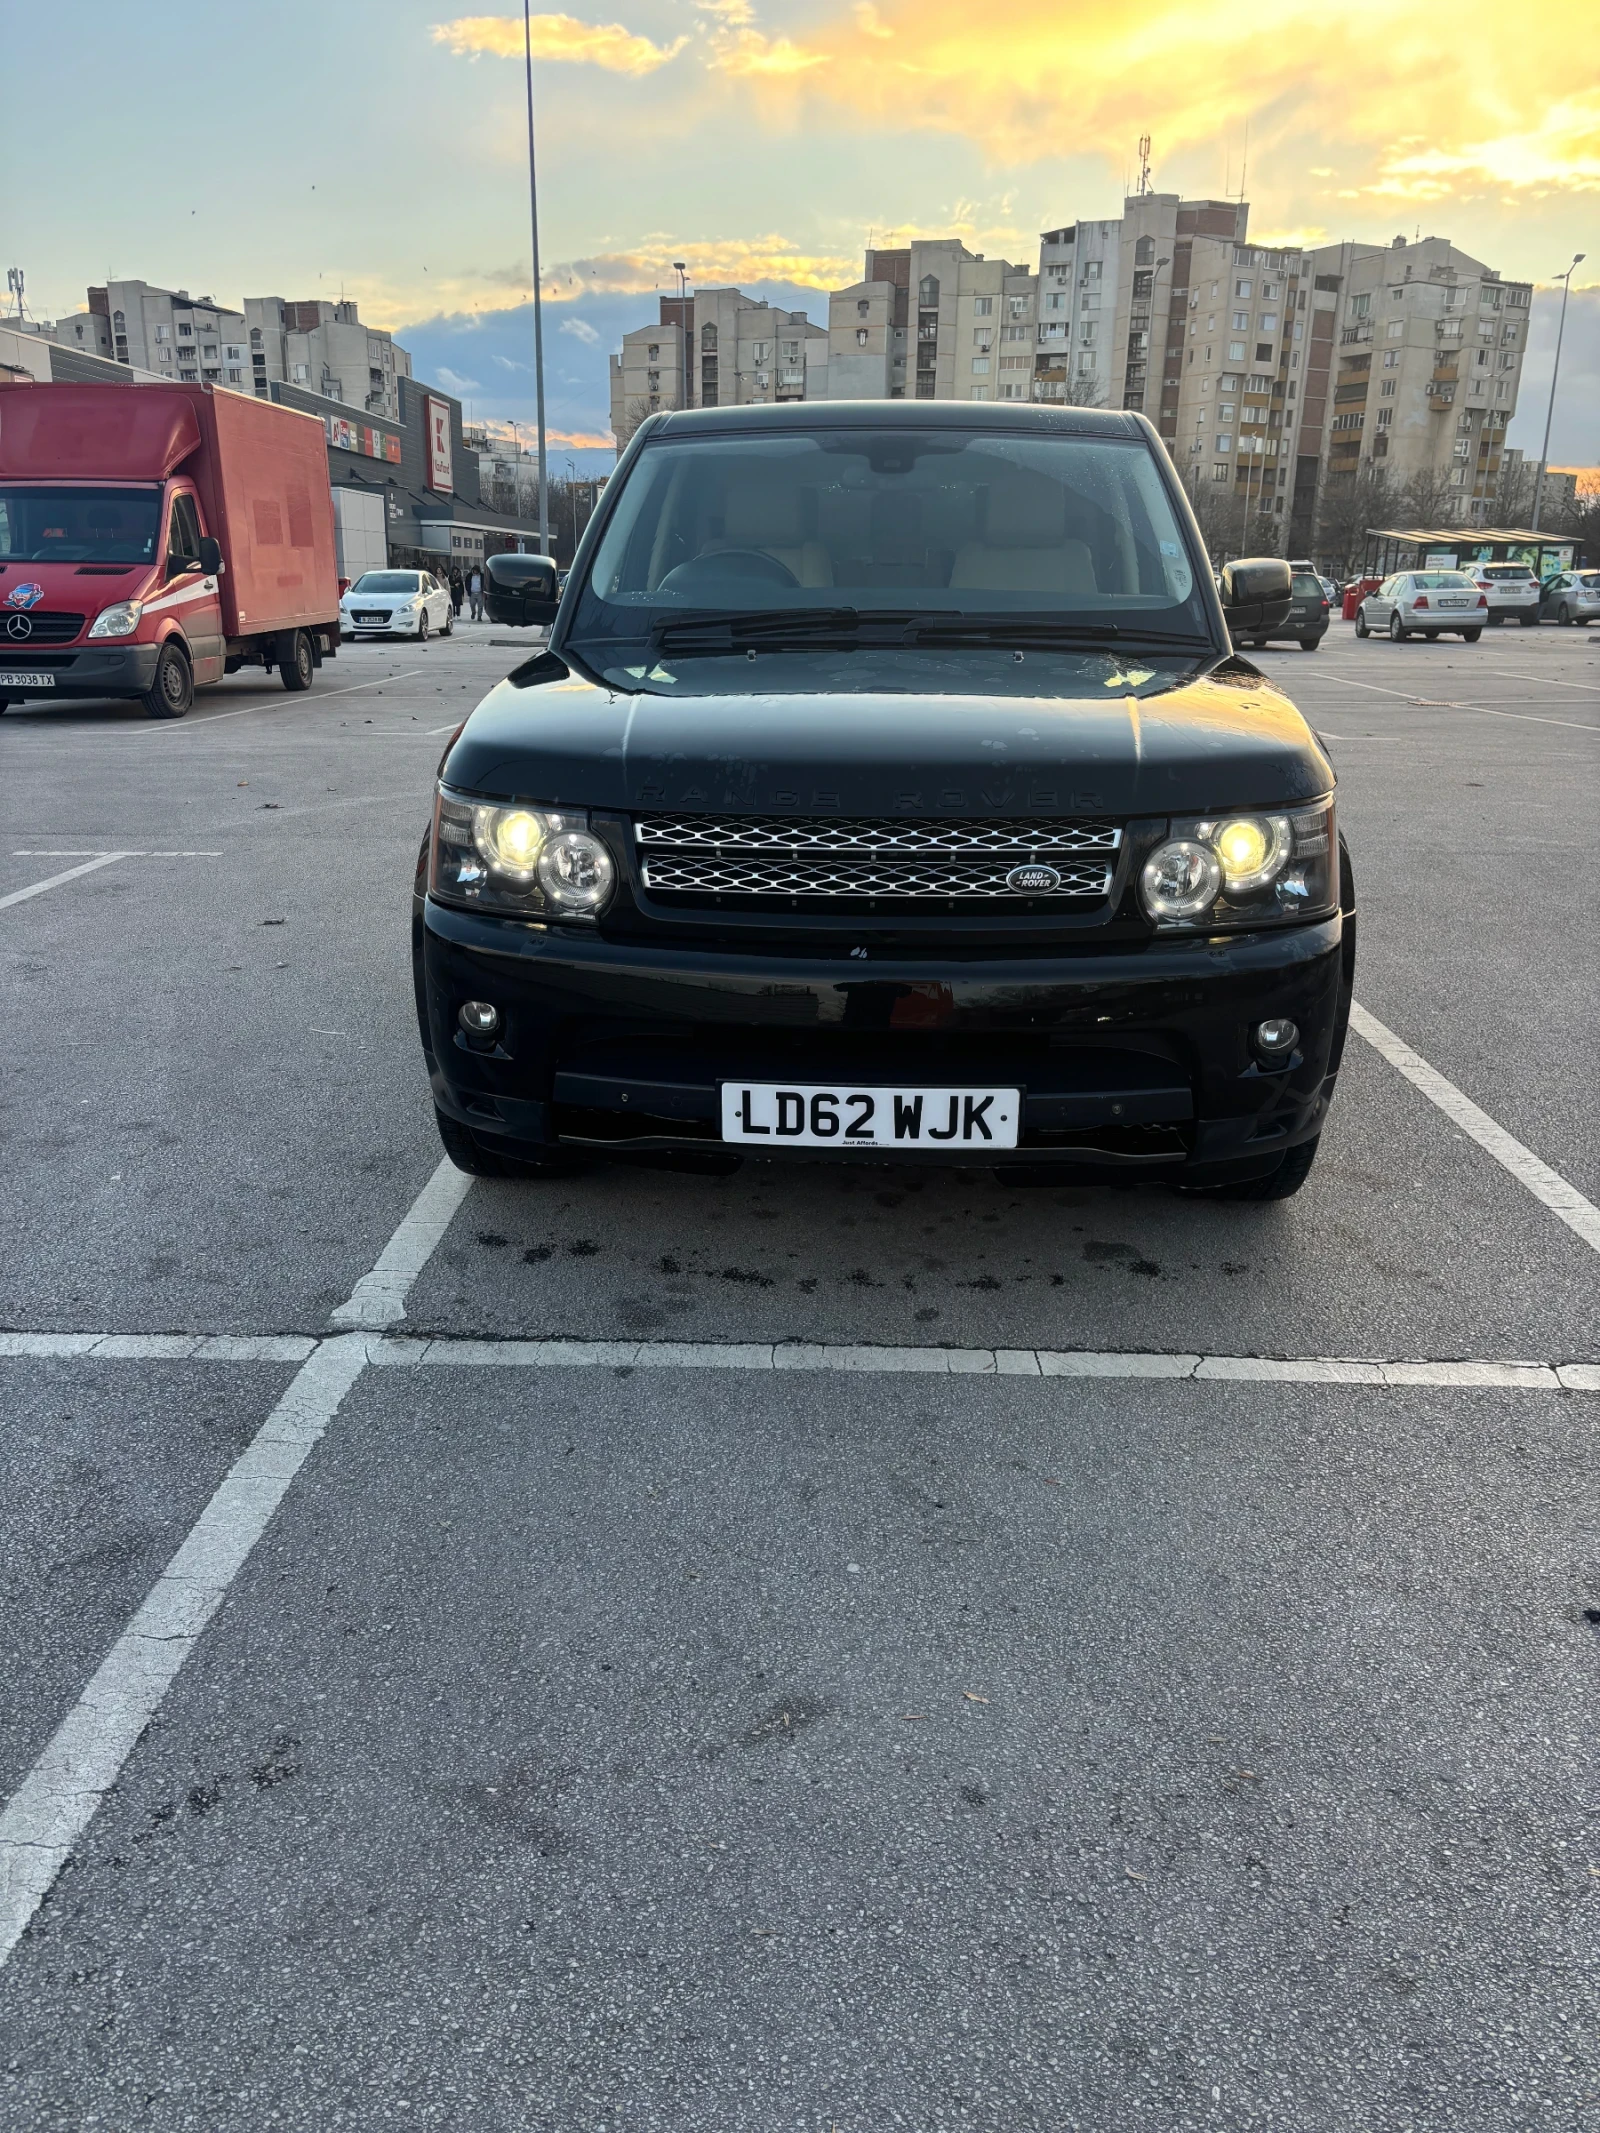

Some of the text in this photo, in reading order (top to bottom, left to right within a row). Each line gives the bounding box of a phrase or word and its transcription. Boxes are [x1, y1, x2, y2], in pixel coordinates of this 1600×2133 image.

[15, 675, 38, 685] 3038
[39, 675, 53, 685] TX
[635, 783, 1105, 809] RANGE ROVER
[1019, 872, 1044, 880] LAND
[742, 1090, 995, 1140] LD62 WJK
